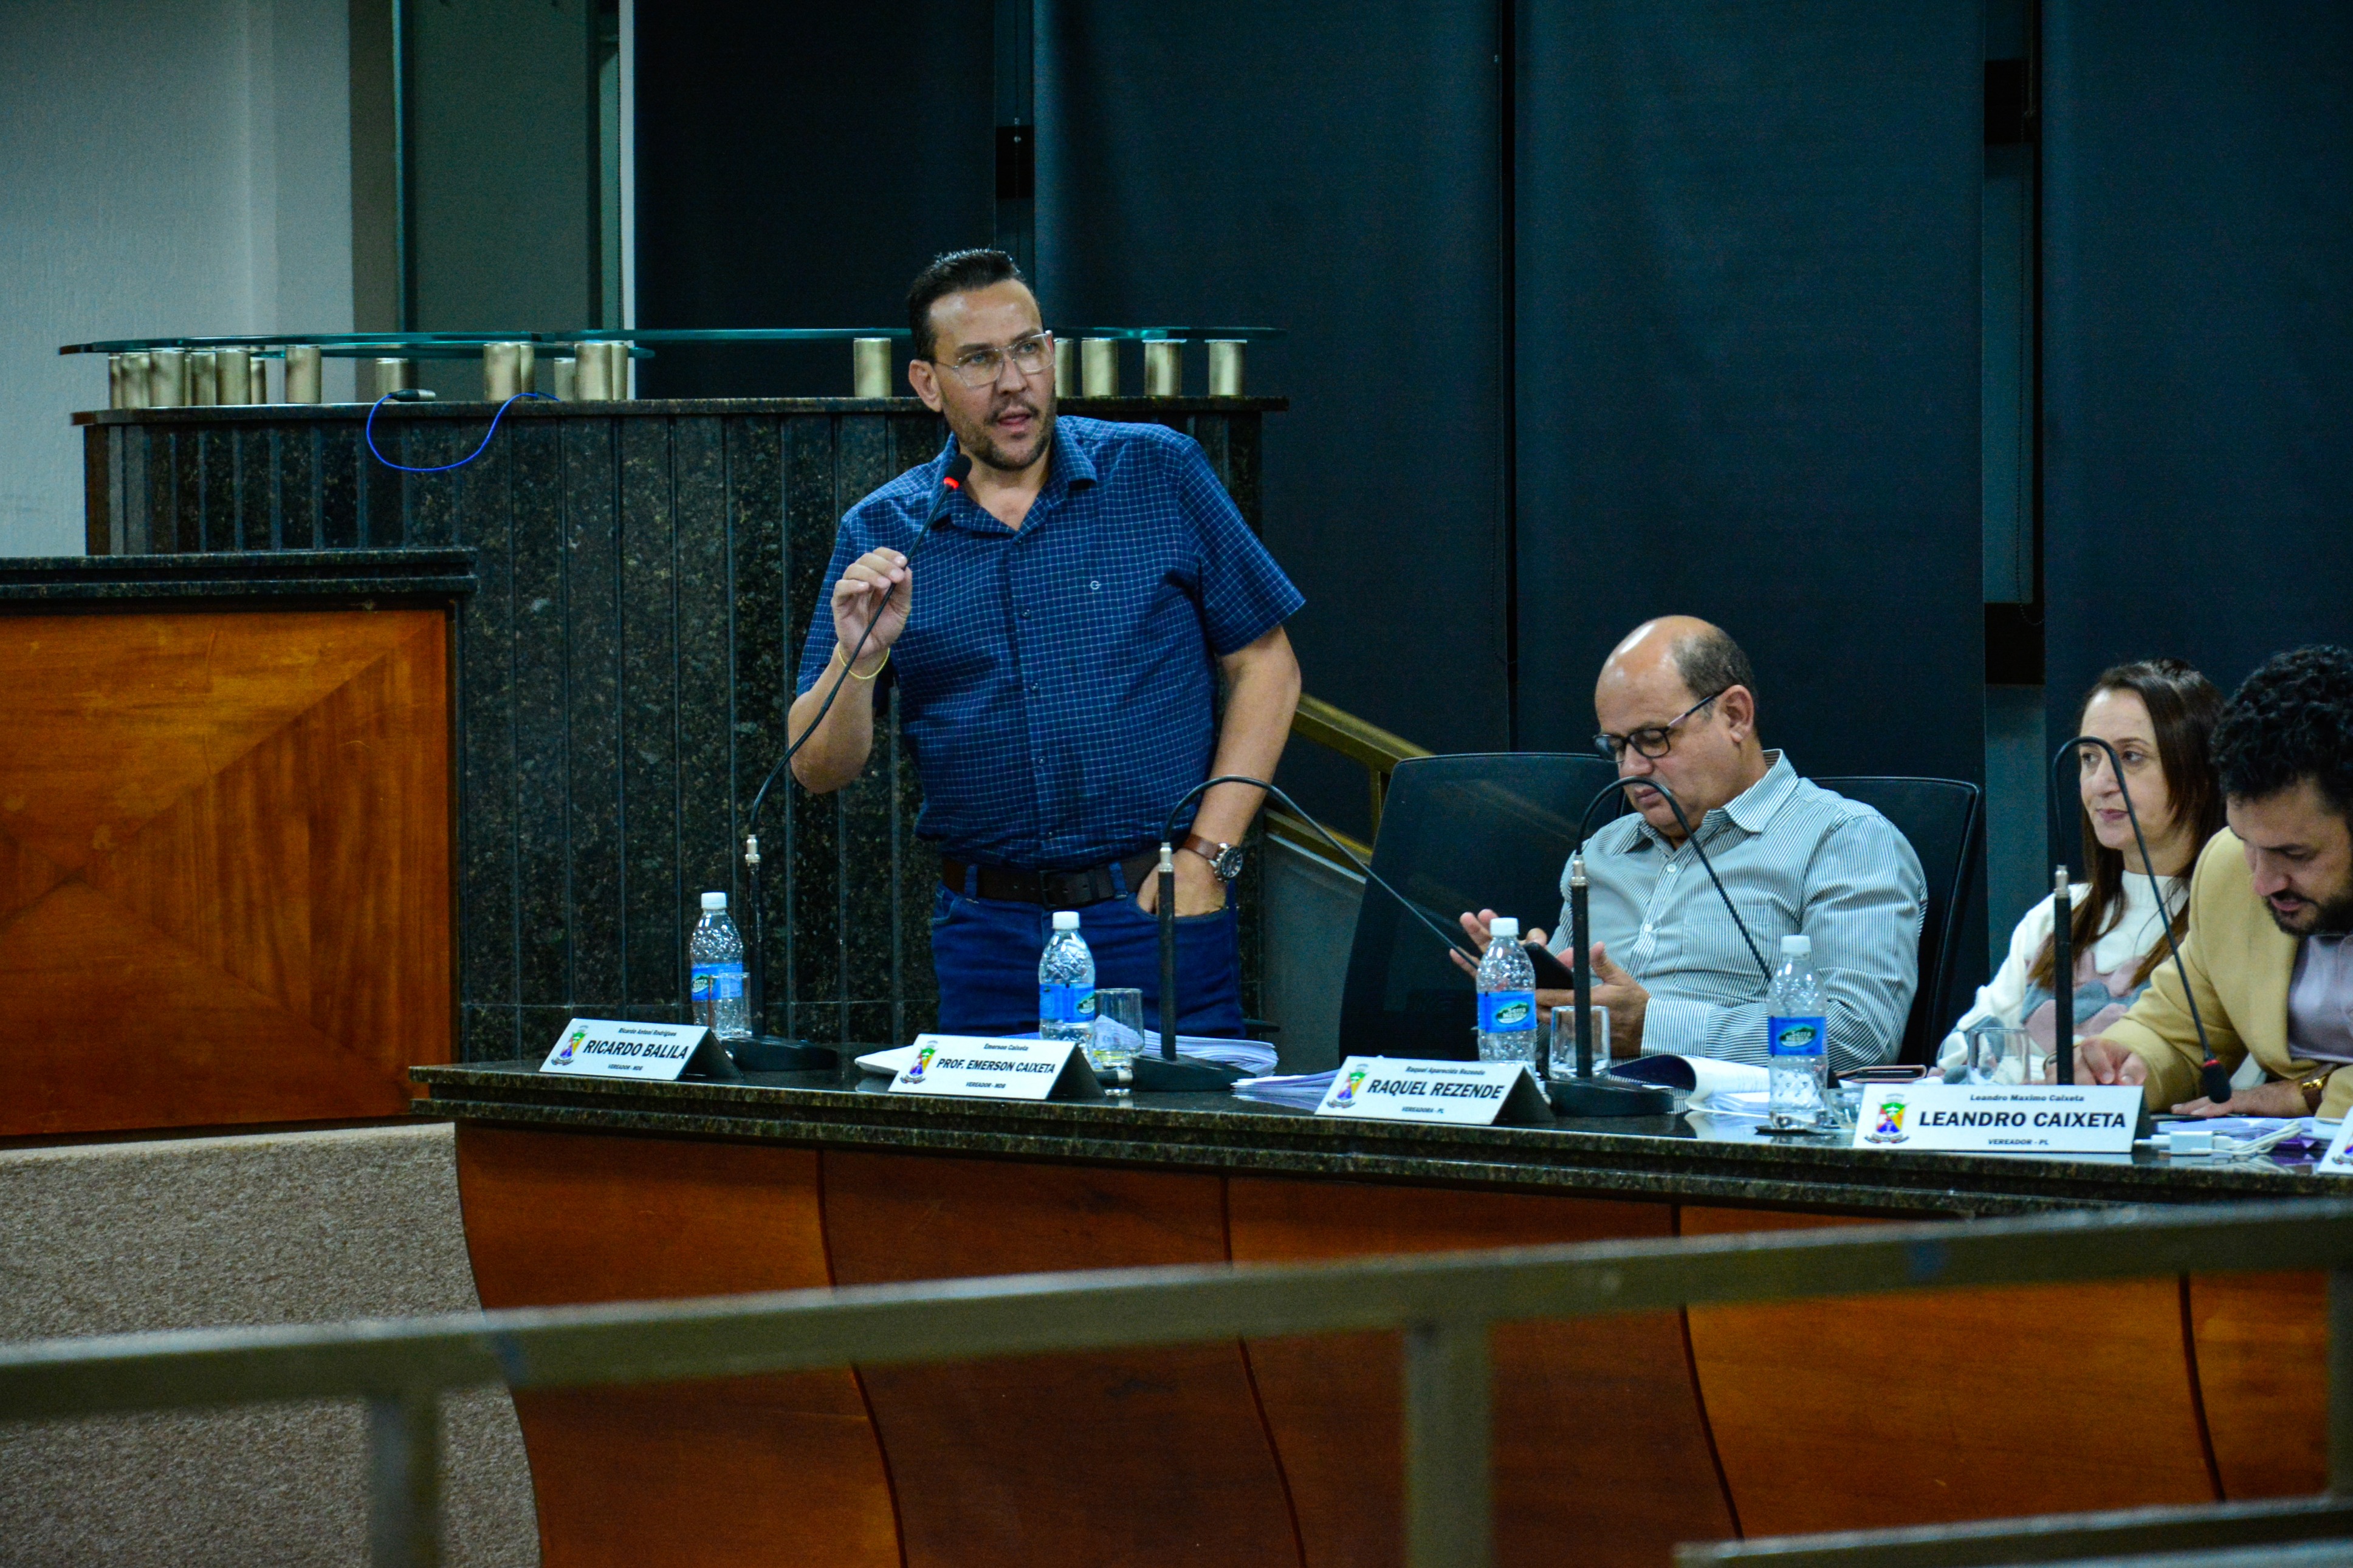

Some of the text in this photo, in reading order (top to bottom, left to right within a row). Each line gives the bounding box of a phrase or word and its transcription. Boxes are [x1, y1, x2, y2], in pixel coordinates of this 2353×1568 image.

[582, 1039, 689, 1059] RICARDO BALILA
[936, 1058, 1056, 1073] PROF. EMERSON CAIXETA
[1367, 1079, 1505, 1099] RAQUEL REZENDE
[1918, 1111, 2126, 1128] LEANDRO CAIXETA
